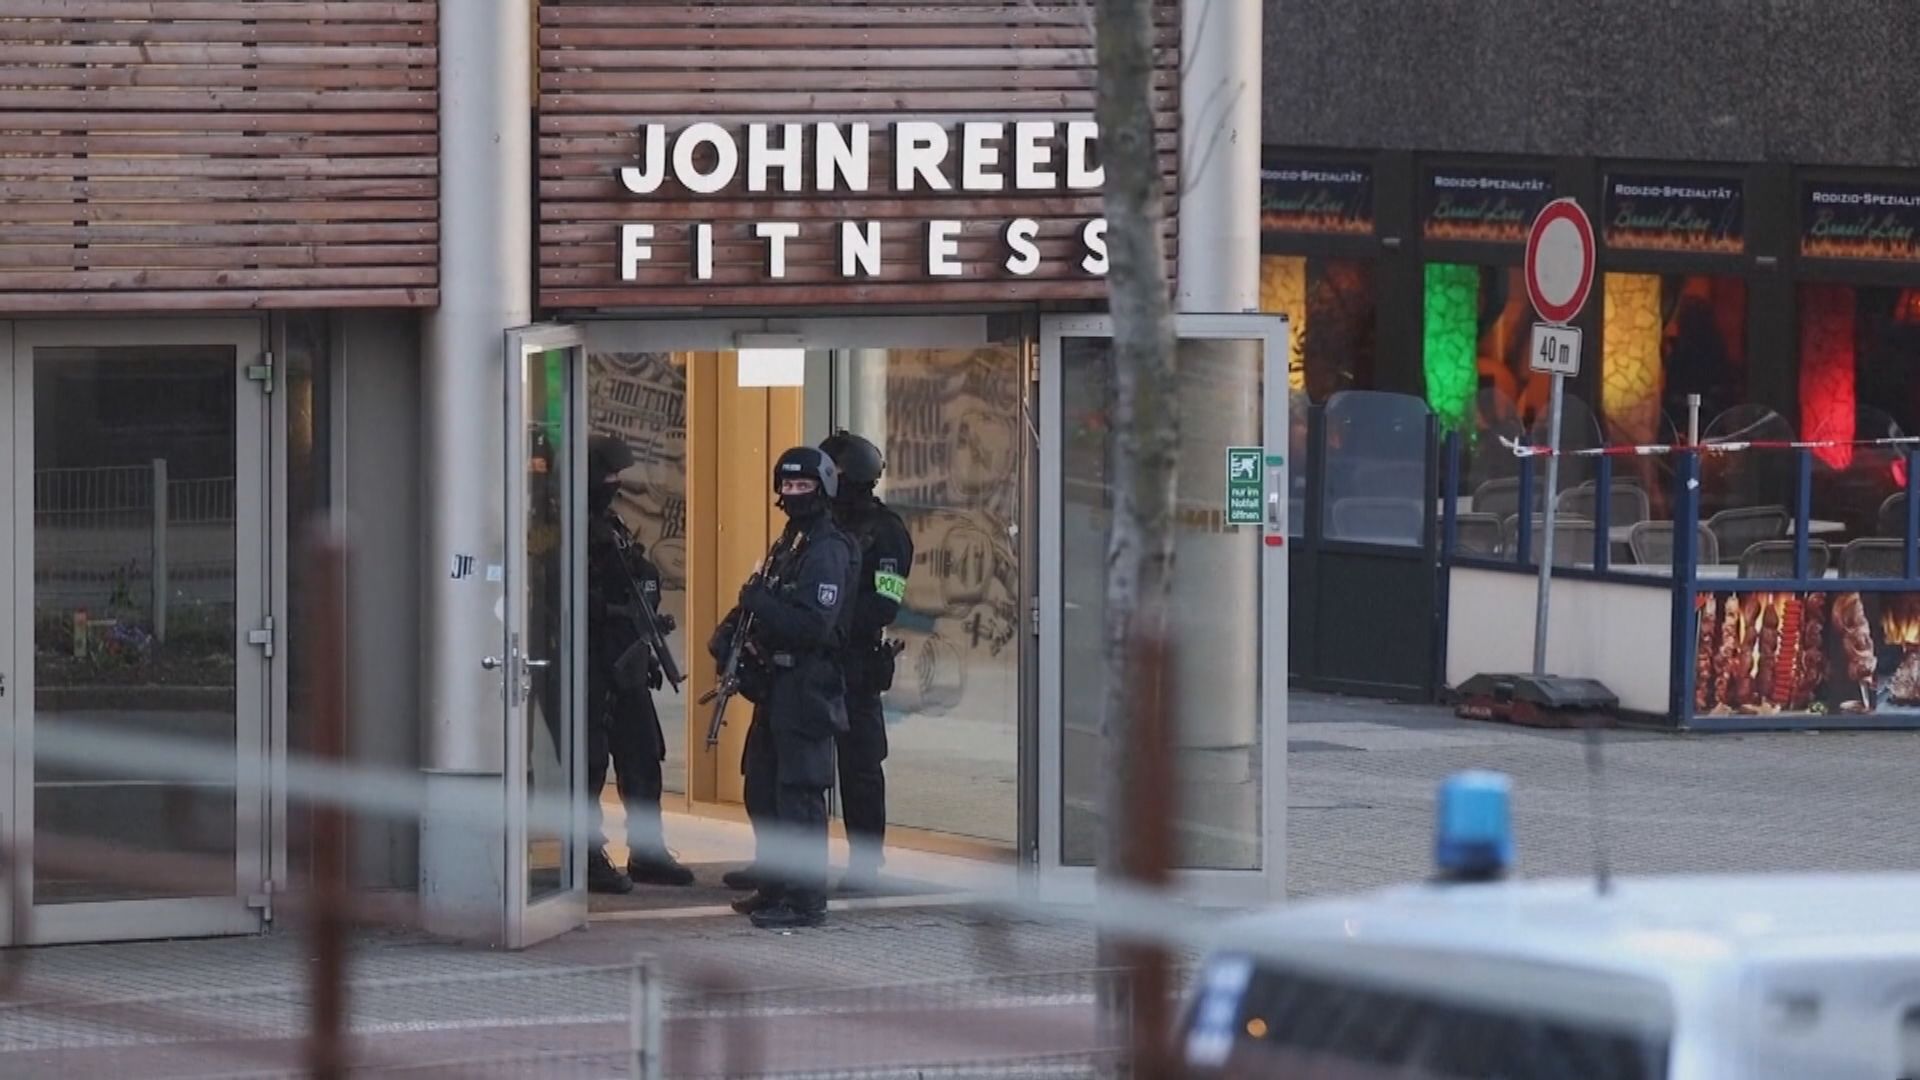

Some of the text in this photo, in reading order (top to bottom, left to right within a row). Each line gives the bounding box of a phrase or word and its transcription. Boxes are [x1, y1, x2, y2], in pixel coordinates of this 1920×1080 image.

[620, 121, 1106, 193] JOHN REED
[621, 219, 1109, 280] FITNESS
[1540, 335, 1570, 365] 40 m
[1231, 486, 1259, 497] nur im
[1231, 497, 1260, 508] Notfall
[1231, 509, 1260, 520] öffnen
